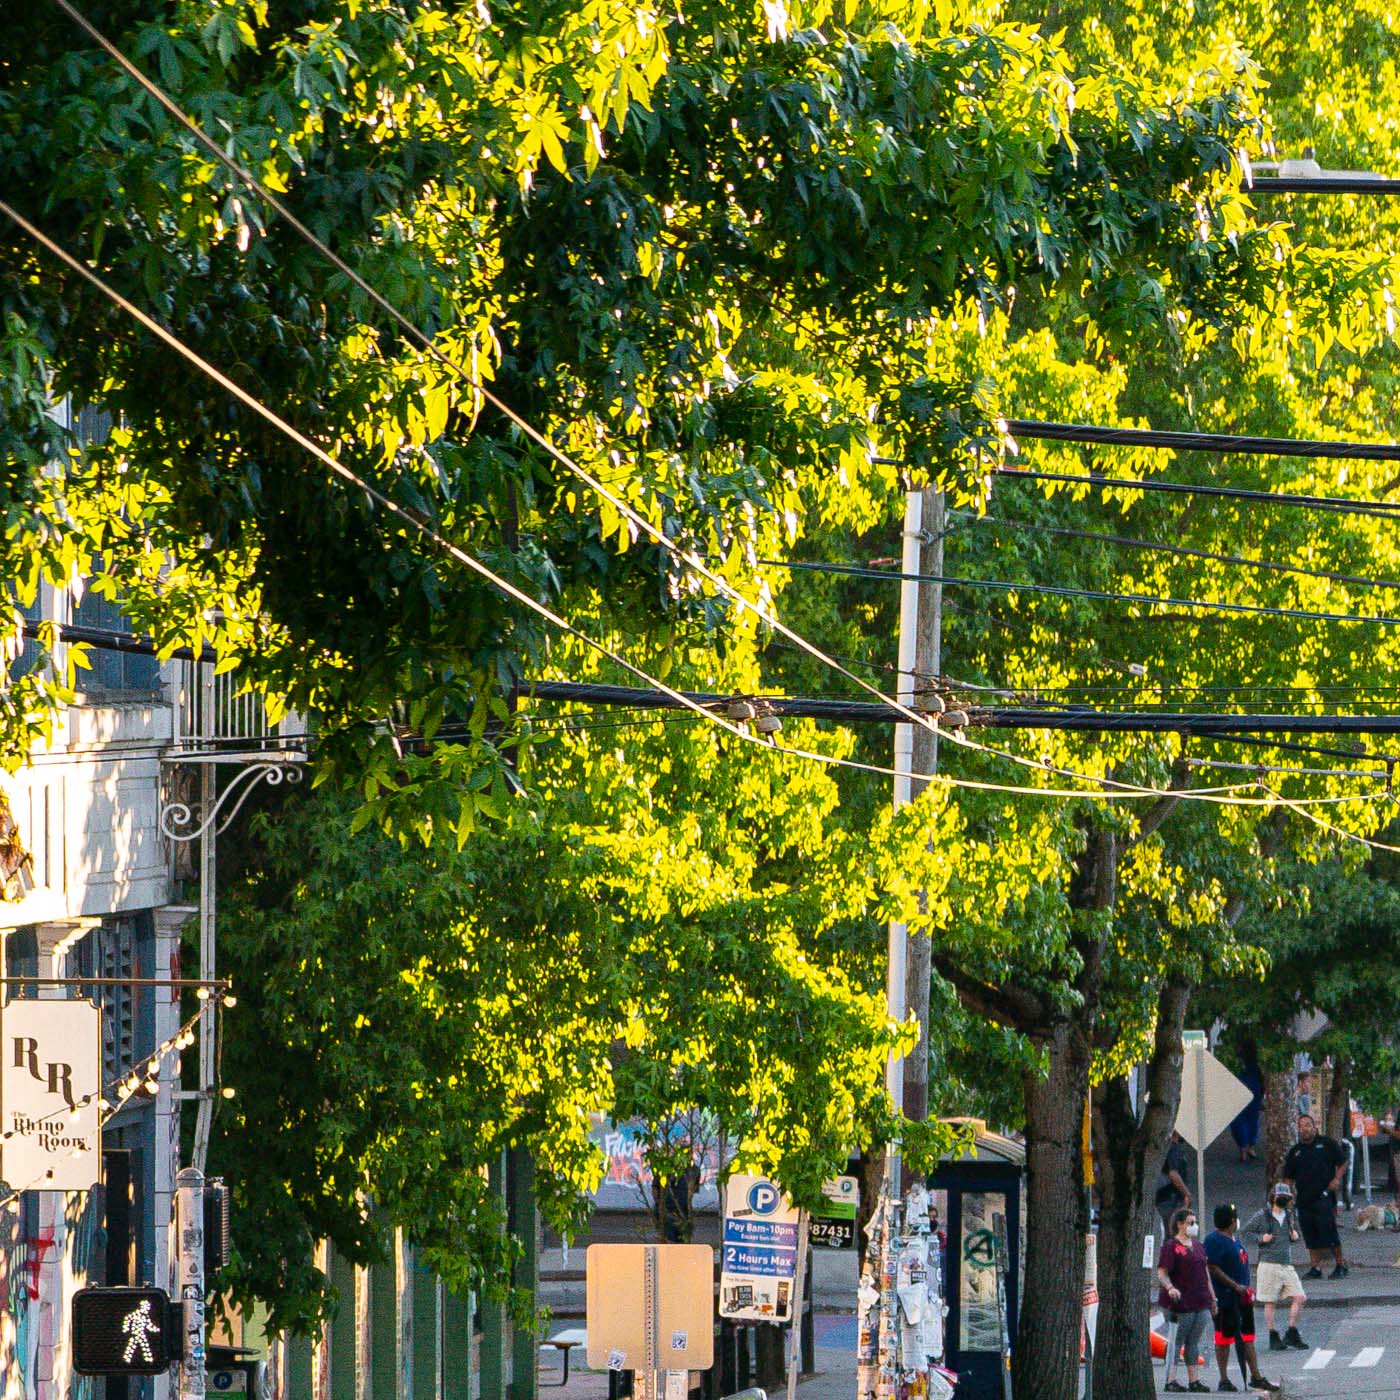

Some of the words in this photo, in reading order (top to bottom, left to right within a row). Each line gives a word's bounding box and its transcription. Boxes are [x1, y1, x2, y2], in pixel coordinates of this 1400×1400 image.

[14, 1118, 64, 1137] Rhino
[728, 1221, 744, 1233] Pay
[727, 1248, 736, 1262] 2
[738, 1251, 768, 1265] Hours
[770, 1253, 792, 1266] Max
